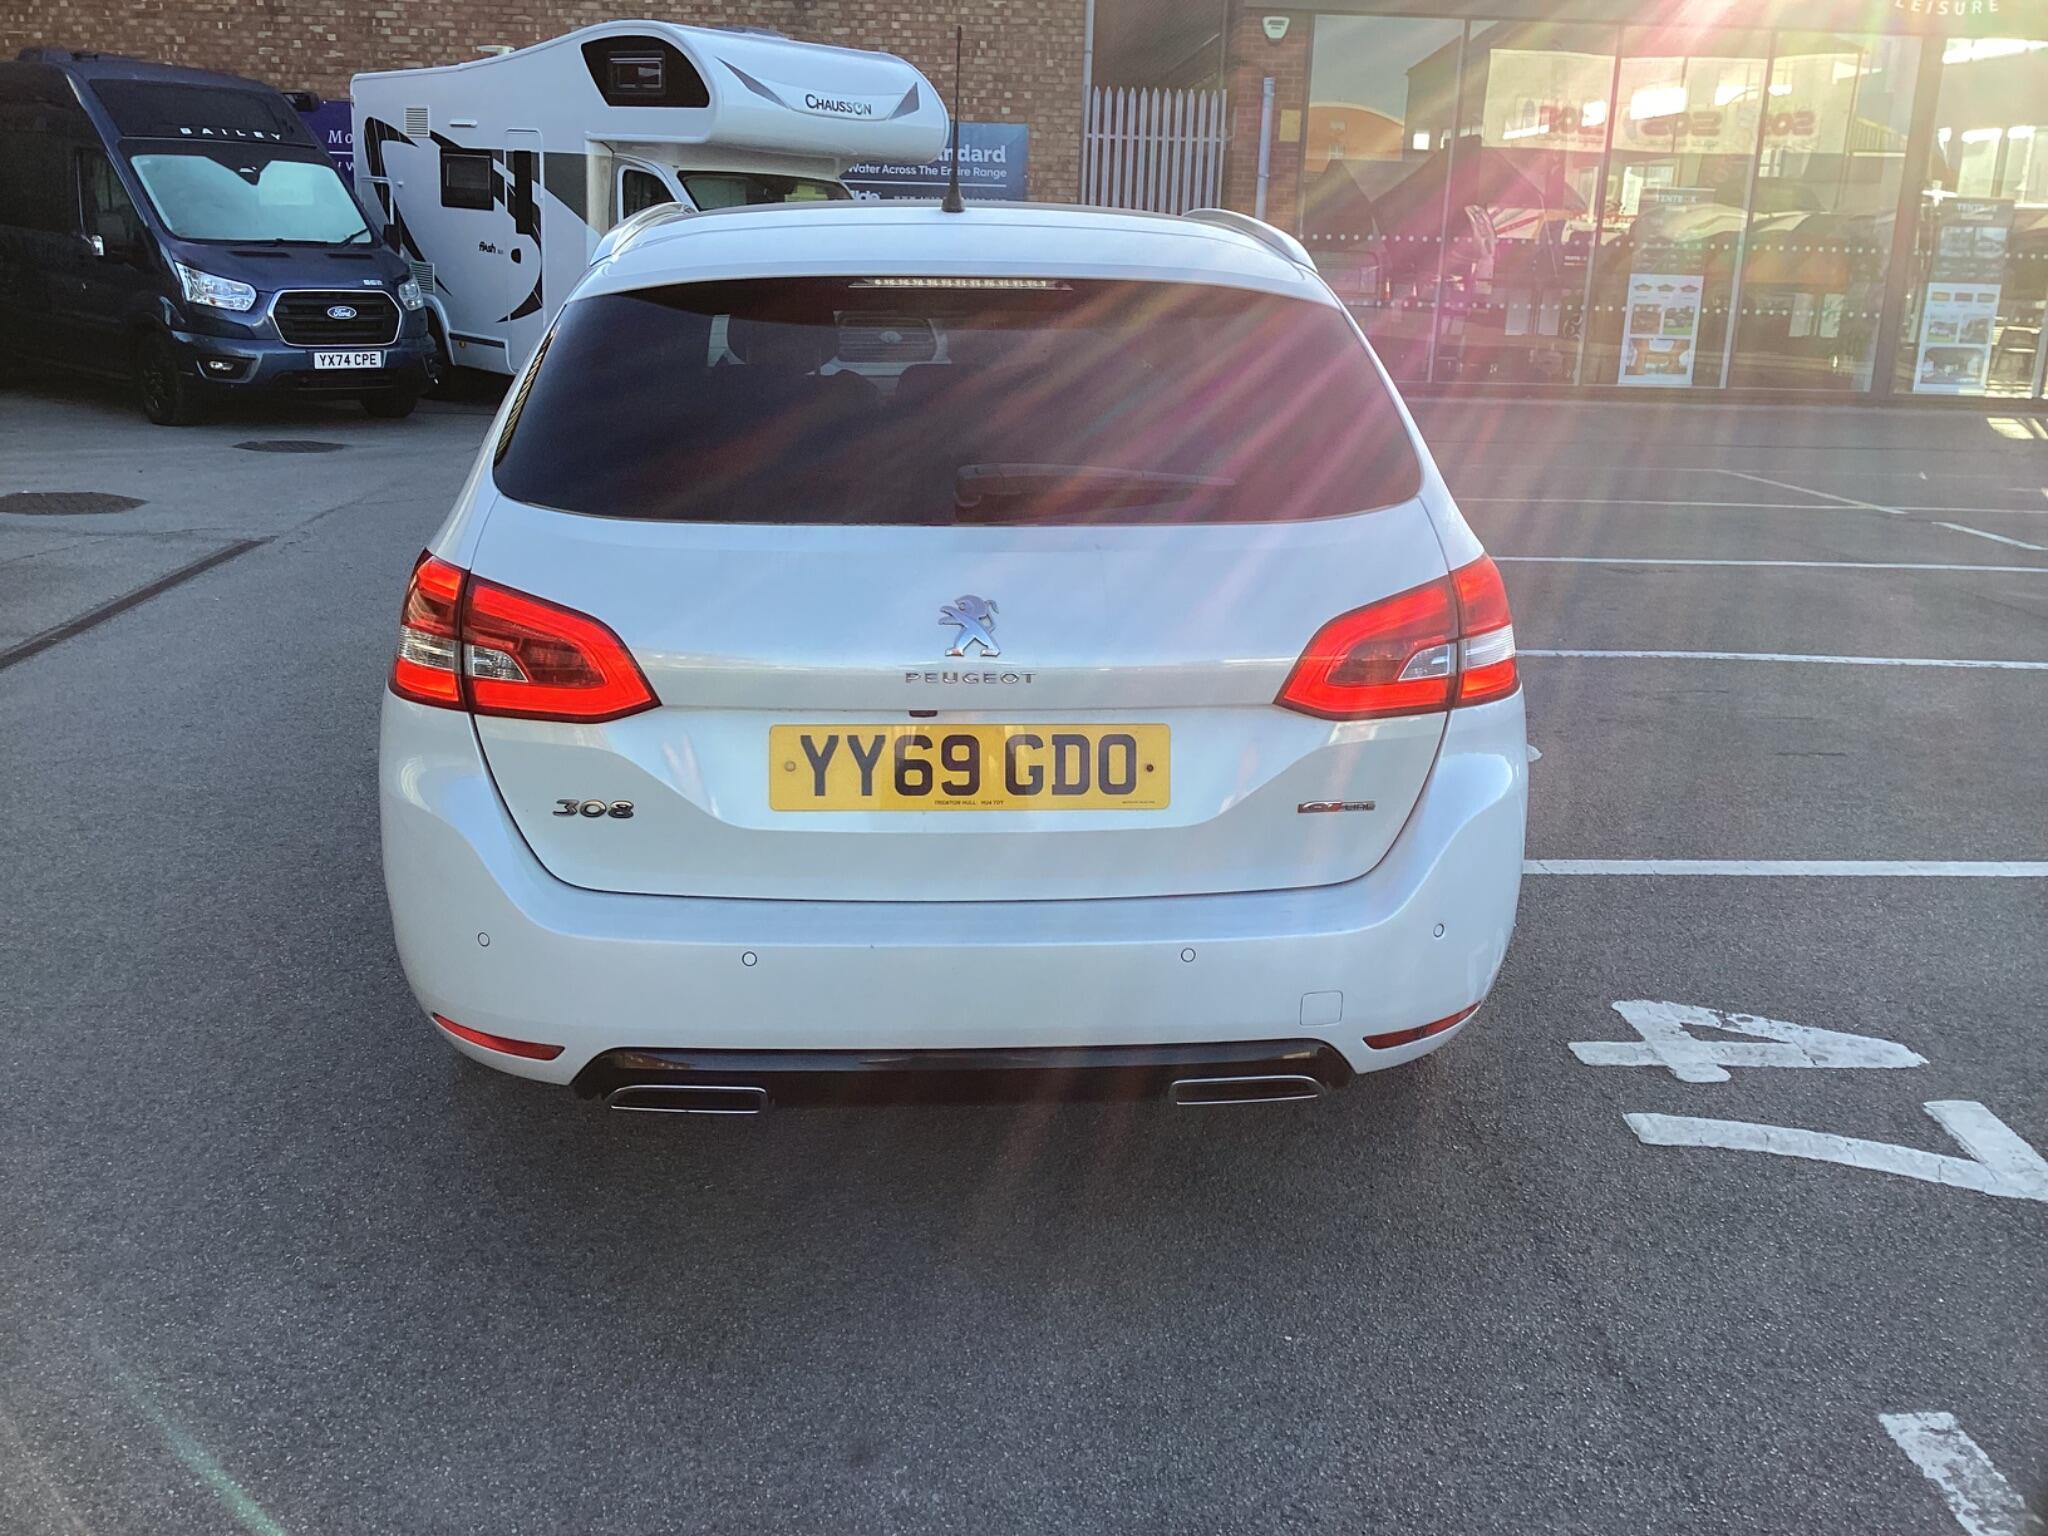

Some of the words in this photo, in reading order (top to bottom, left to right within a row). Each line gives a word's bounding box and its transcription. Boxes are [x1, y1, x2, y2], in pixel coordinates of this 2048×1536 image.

[1894, 0, 1999, 16] LEISURE
[804, 93, 872, 115] CHAUSSON
[179, 127, 281, 141] BAILEY
[937, 144, 1007, 163] ndard
[882, 165, 917, 176] Across
[918, 165, 938, 176] The
[940, 166, 970, 177] Enire
[973, 167, 1007, 180] Range
[333, 308, 351, 317] Ford
[319, 354, 351, 366] YX74
[354, 354, 377, 366] CPE
[905, 672, 1037, 684] PEUGEOT
[800, 734, 980, 797] YY69
[1004, 734, 1137, 796] GDO
[552, 799, 634, 819] 308
